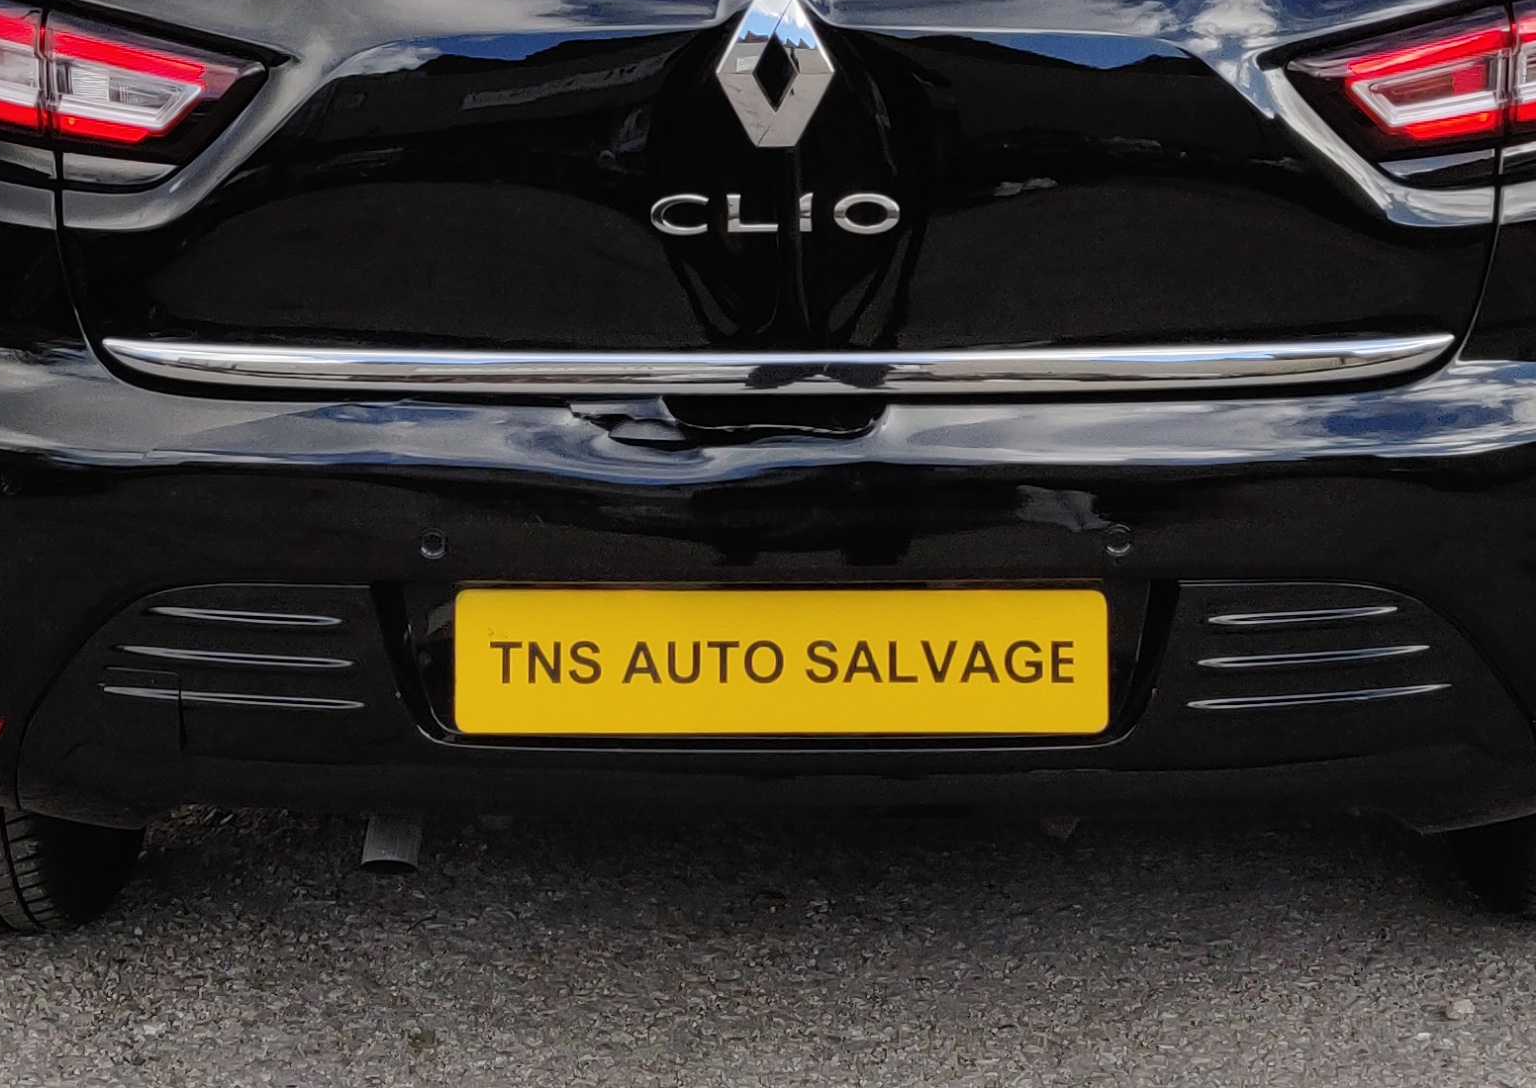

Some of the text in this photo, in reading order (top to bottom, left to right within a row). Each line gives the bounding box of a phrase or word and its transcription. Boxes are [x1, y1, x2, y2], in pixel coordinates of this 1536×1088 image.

[650, 192, 900, 235] CLIO
[490, 640, 1075, 684] TNS AUTO SALVAGE
